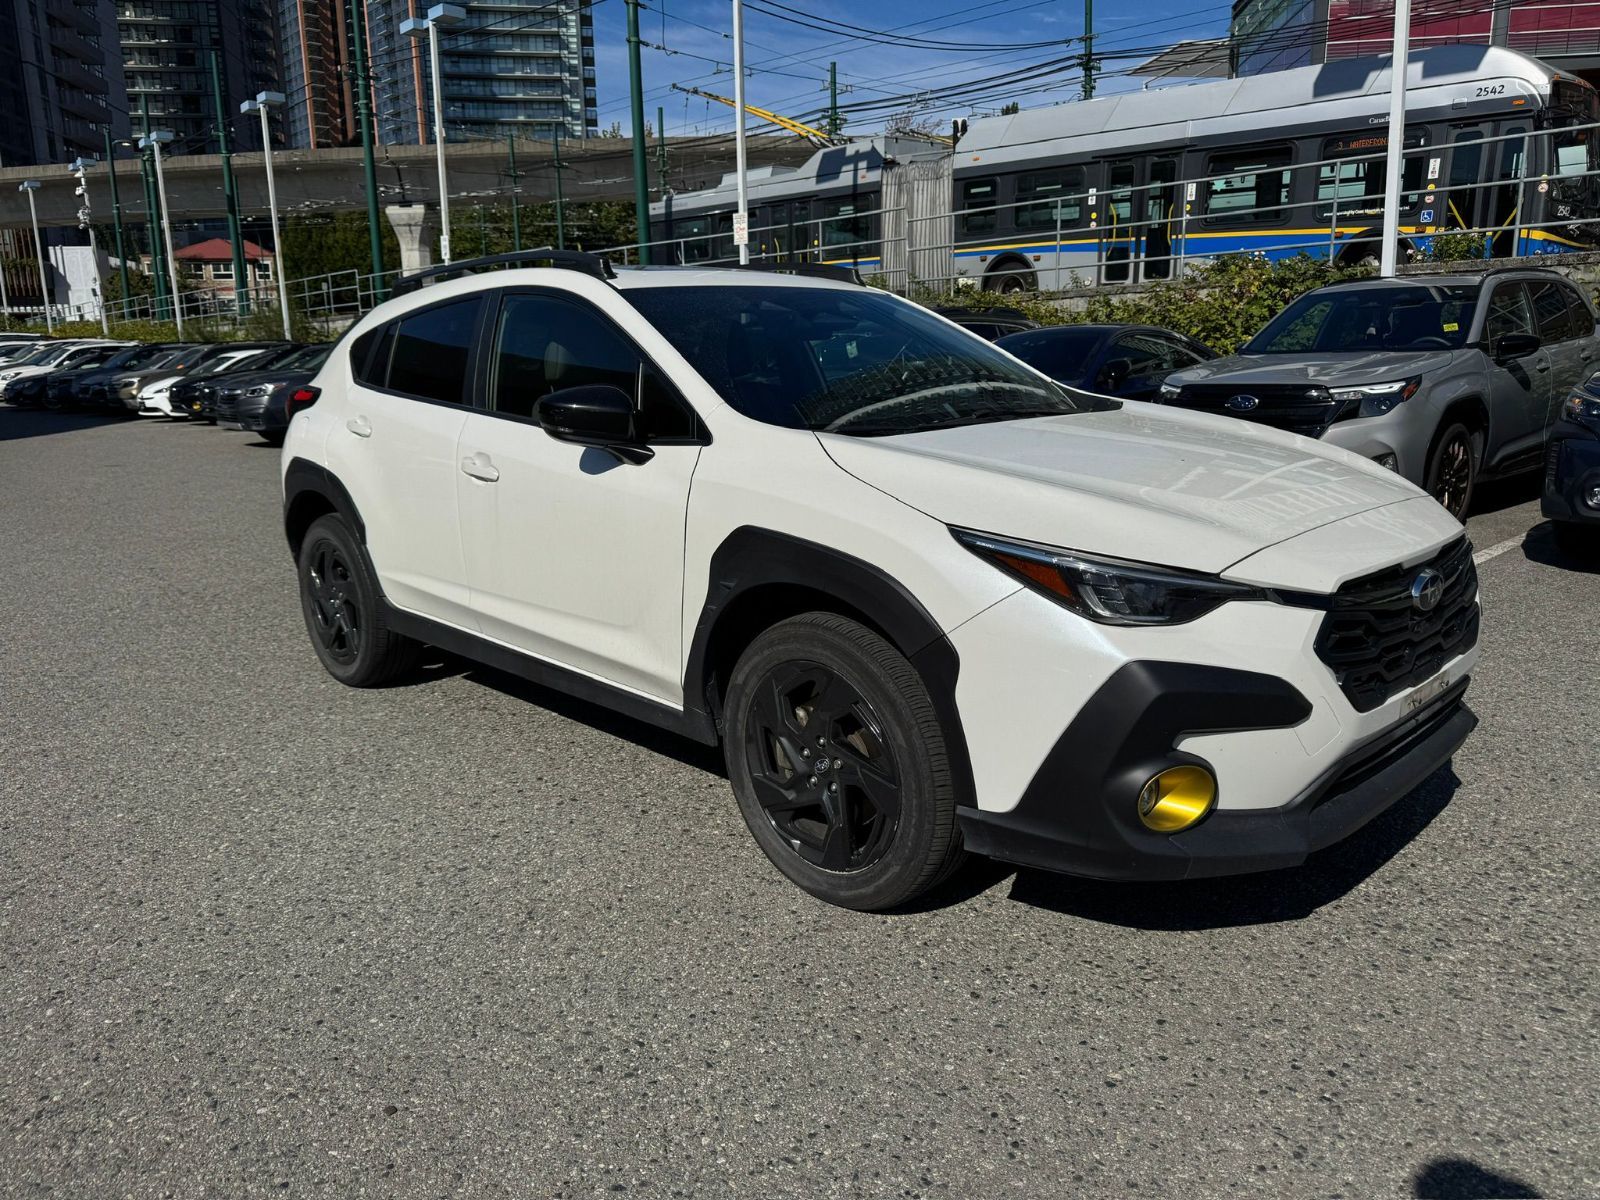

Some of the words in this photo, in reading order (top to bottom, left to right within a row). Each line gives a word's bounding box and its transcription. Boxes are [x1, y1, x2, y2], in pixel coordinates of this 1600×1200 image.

[1475, 84, 1505, 97] 2542
[1369, 116, 1390, 124] Canad
[1349, 137, 1388, 149] WATERFRON
